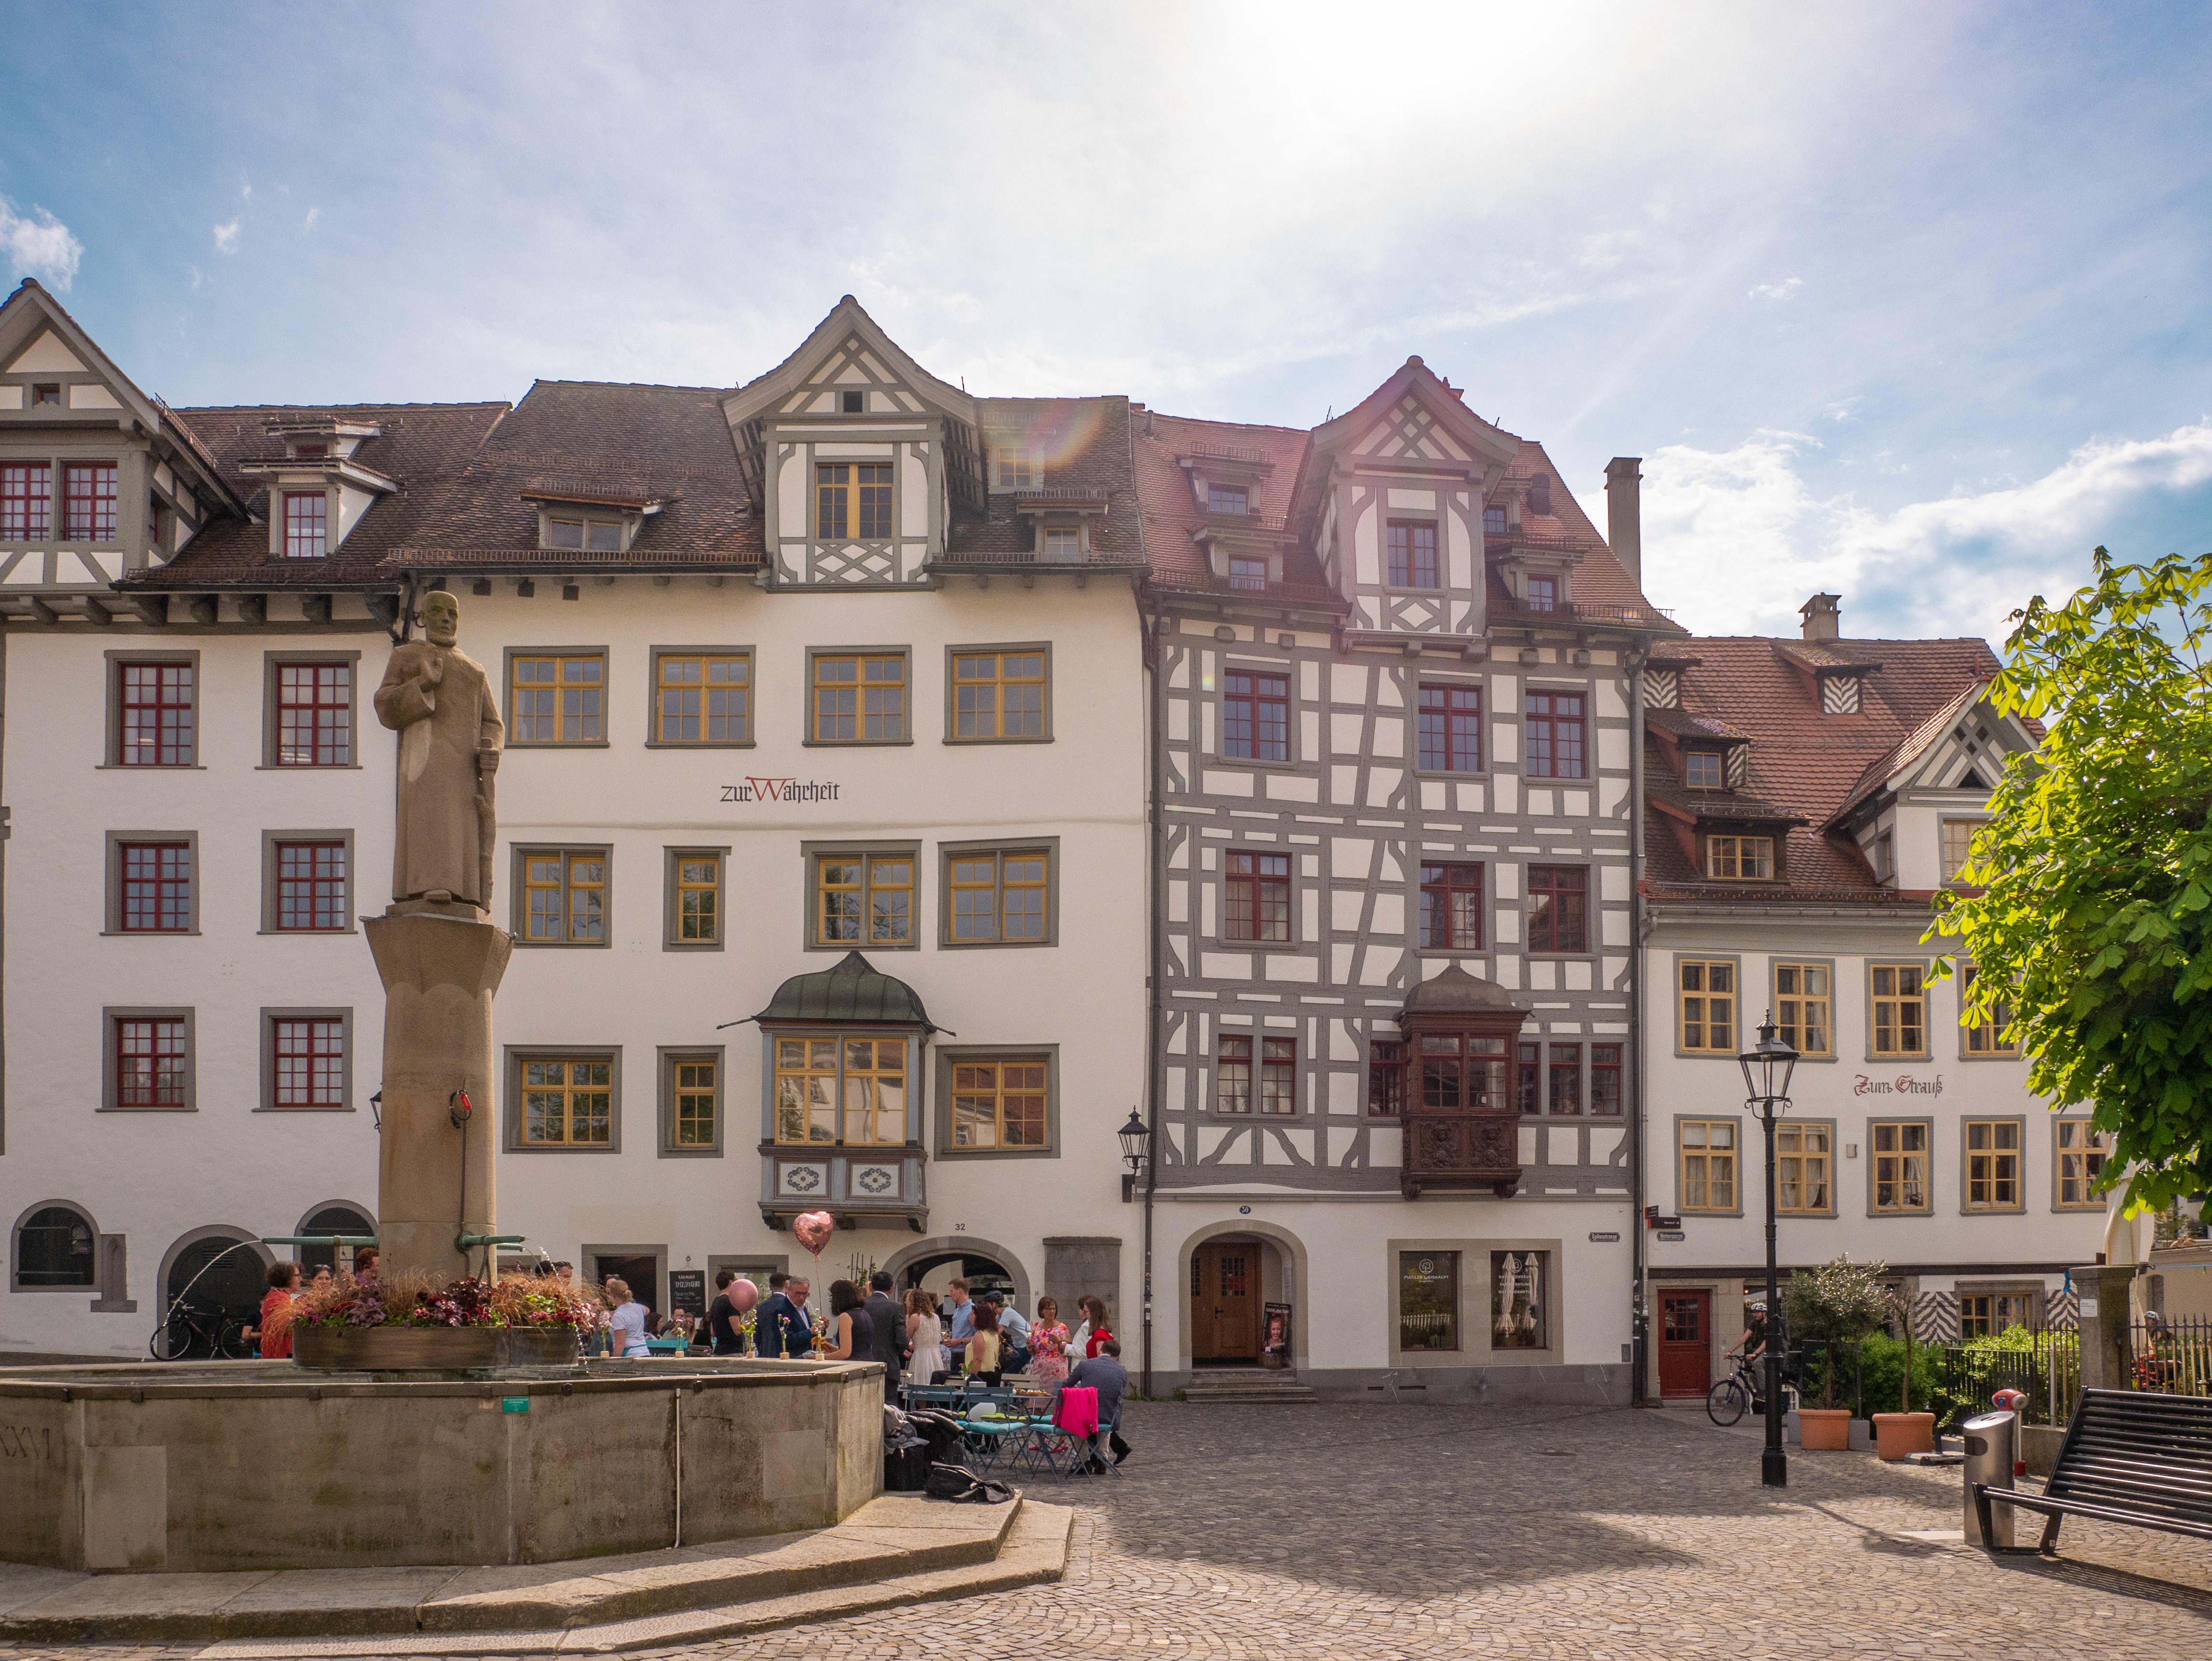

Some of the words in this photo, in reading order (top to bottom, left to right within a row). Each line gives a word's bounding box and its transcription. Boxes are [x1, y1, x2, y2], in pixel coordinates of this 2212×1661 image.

[720, 785, 752, 802] zur
[744, 776, 841, 804] Wahrheit
[1854, 1074, 1893, 1096] Zum
[1895, 1074, 1944, 1098] Strauß
